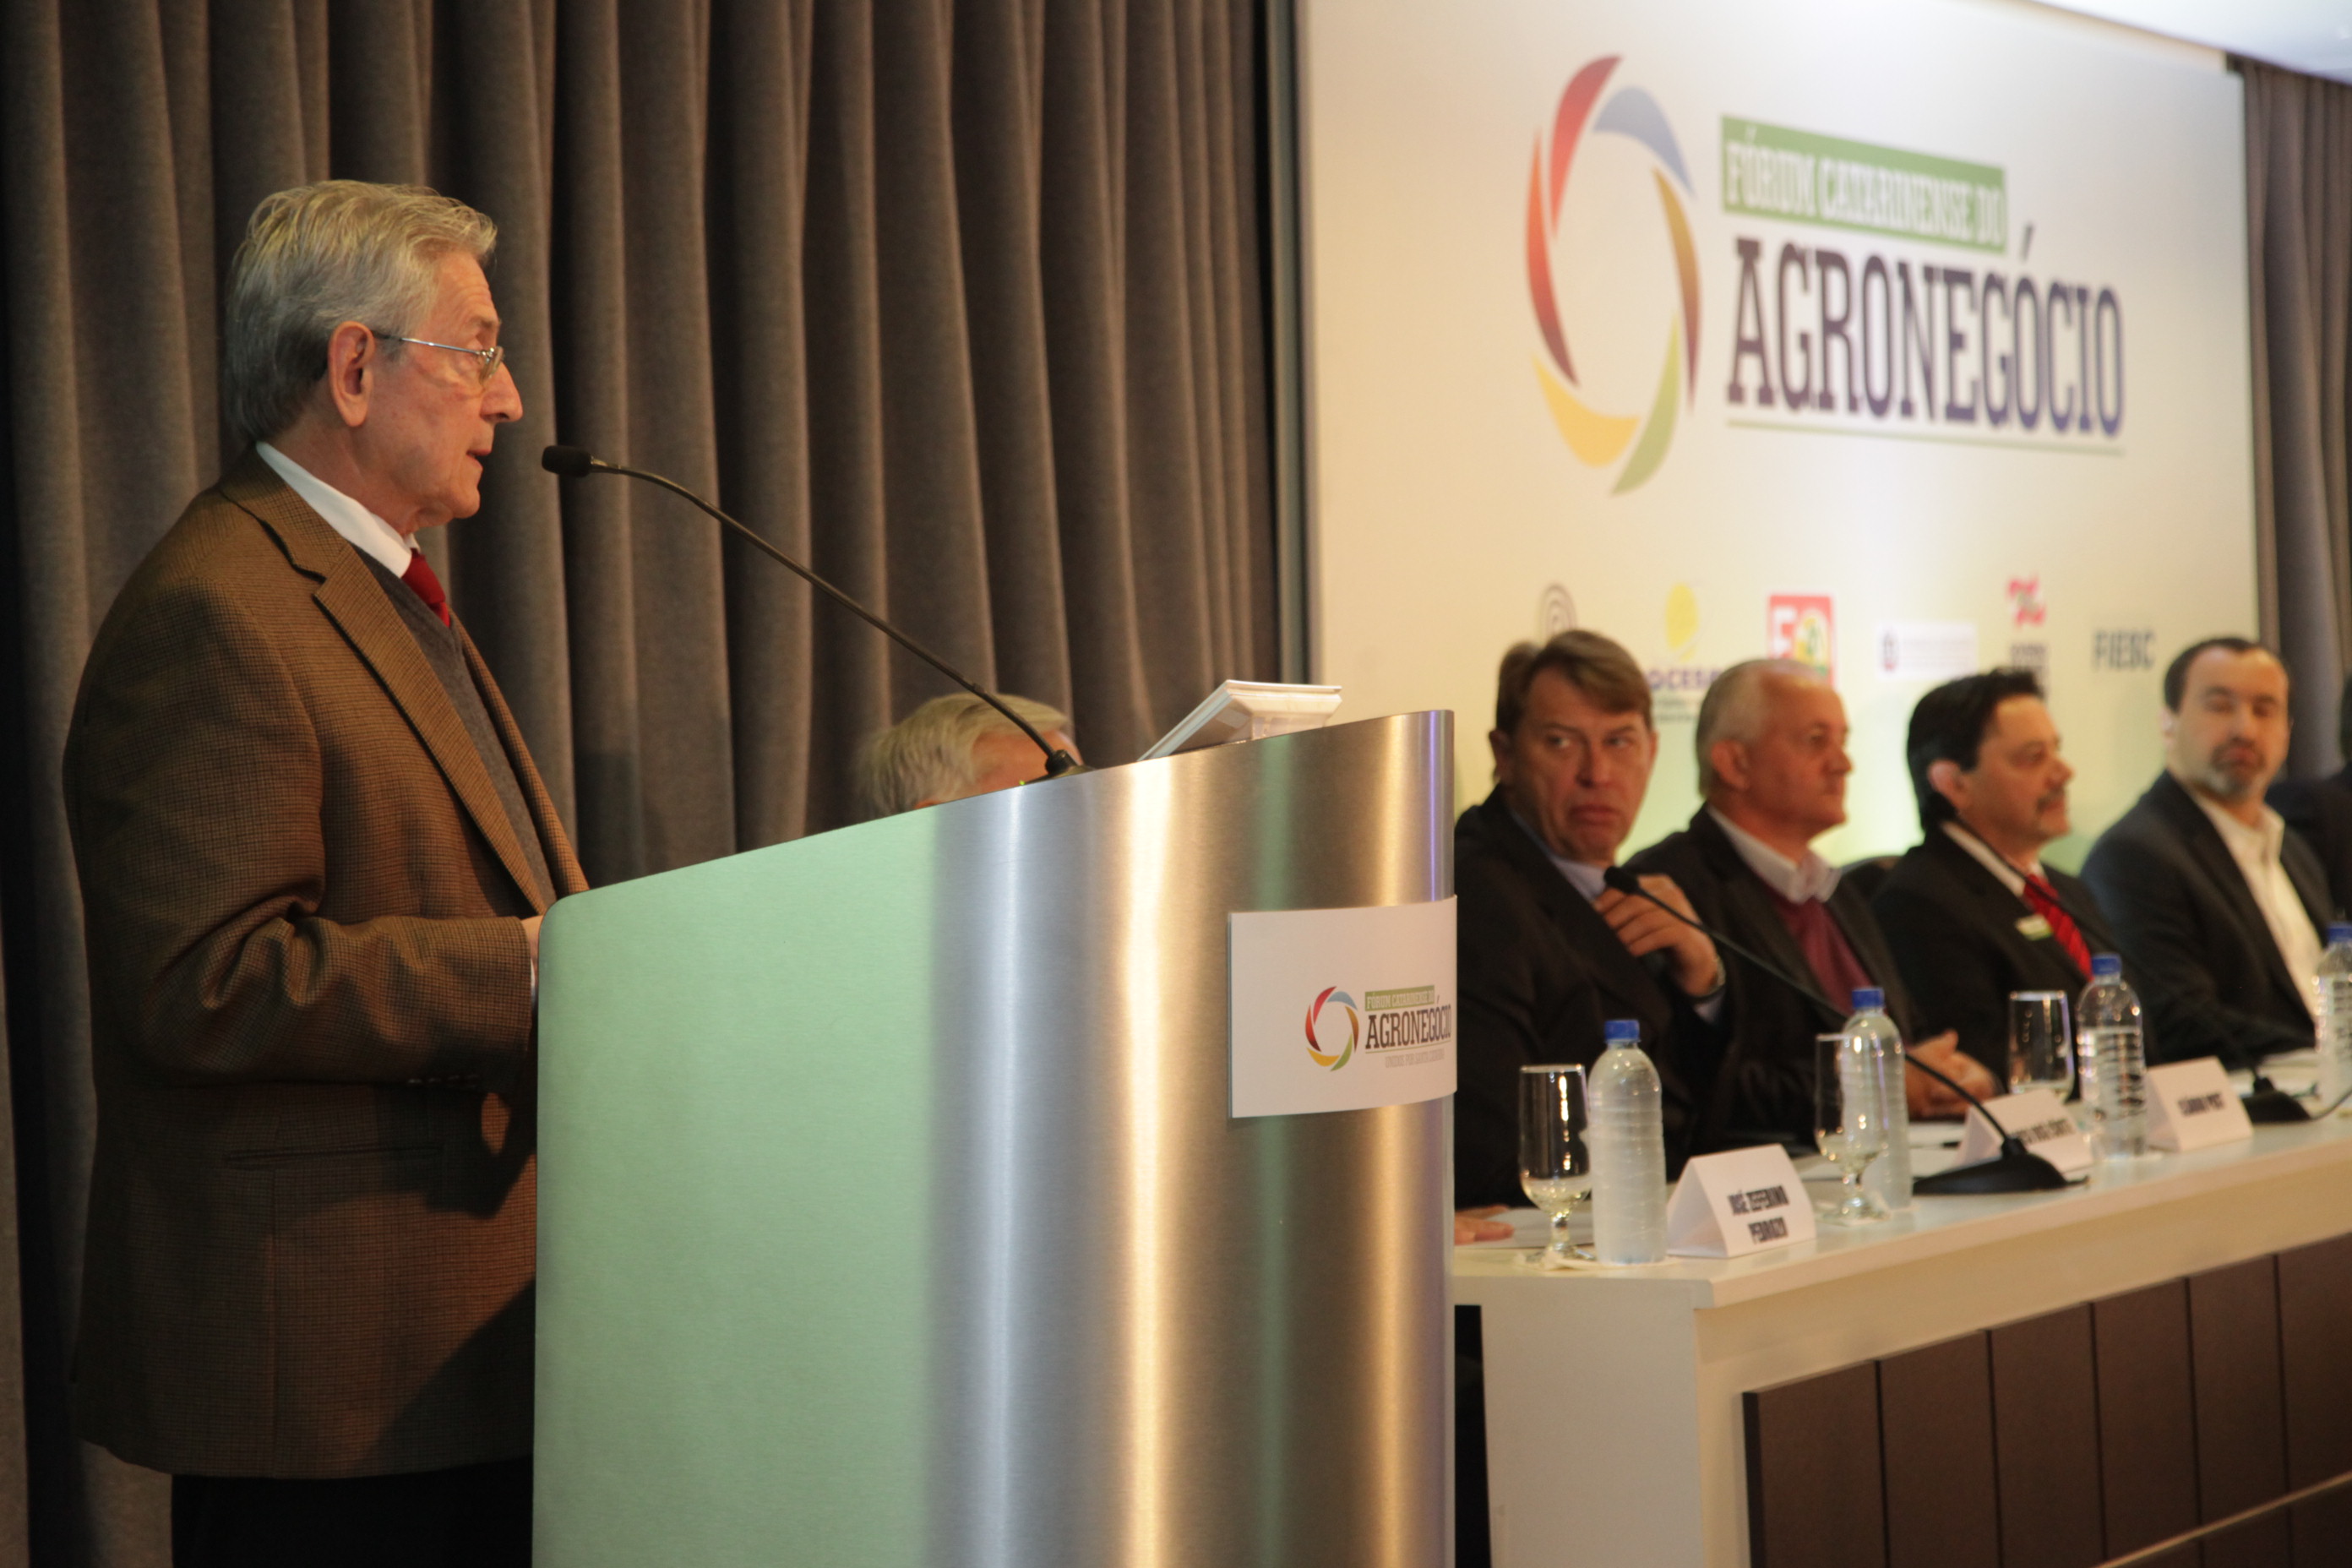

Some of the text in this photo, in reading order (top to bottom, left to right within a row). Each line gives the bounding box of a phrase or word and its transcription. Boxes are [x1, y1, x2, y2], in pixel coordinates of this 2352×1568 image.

[1726, 224, 2124, 438] AGRONEGÓCIO
[1365, 994, 1451, 1049] AGRONEGÓCIO
[1367, 992, 1391, 1010] FÓRUM
[1391, 991, 1428, 1007] CATARINENSE
